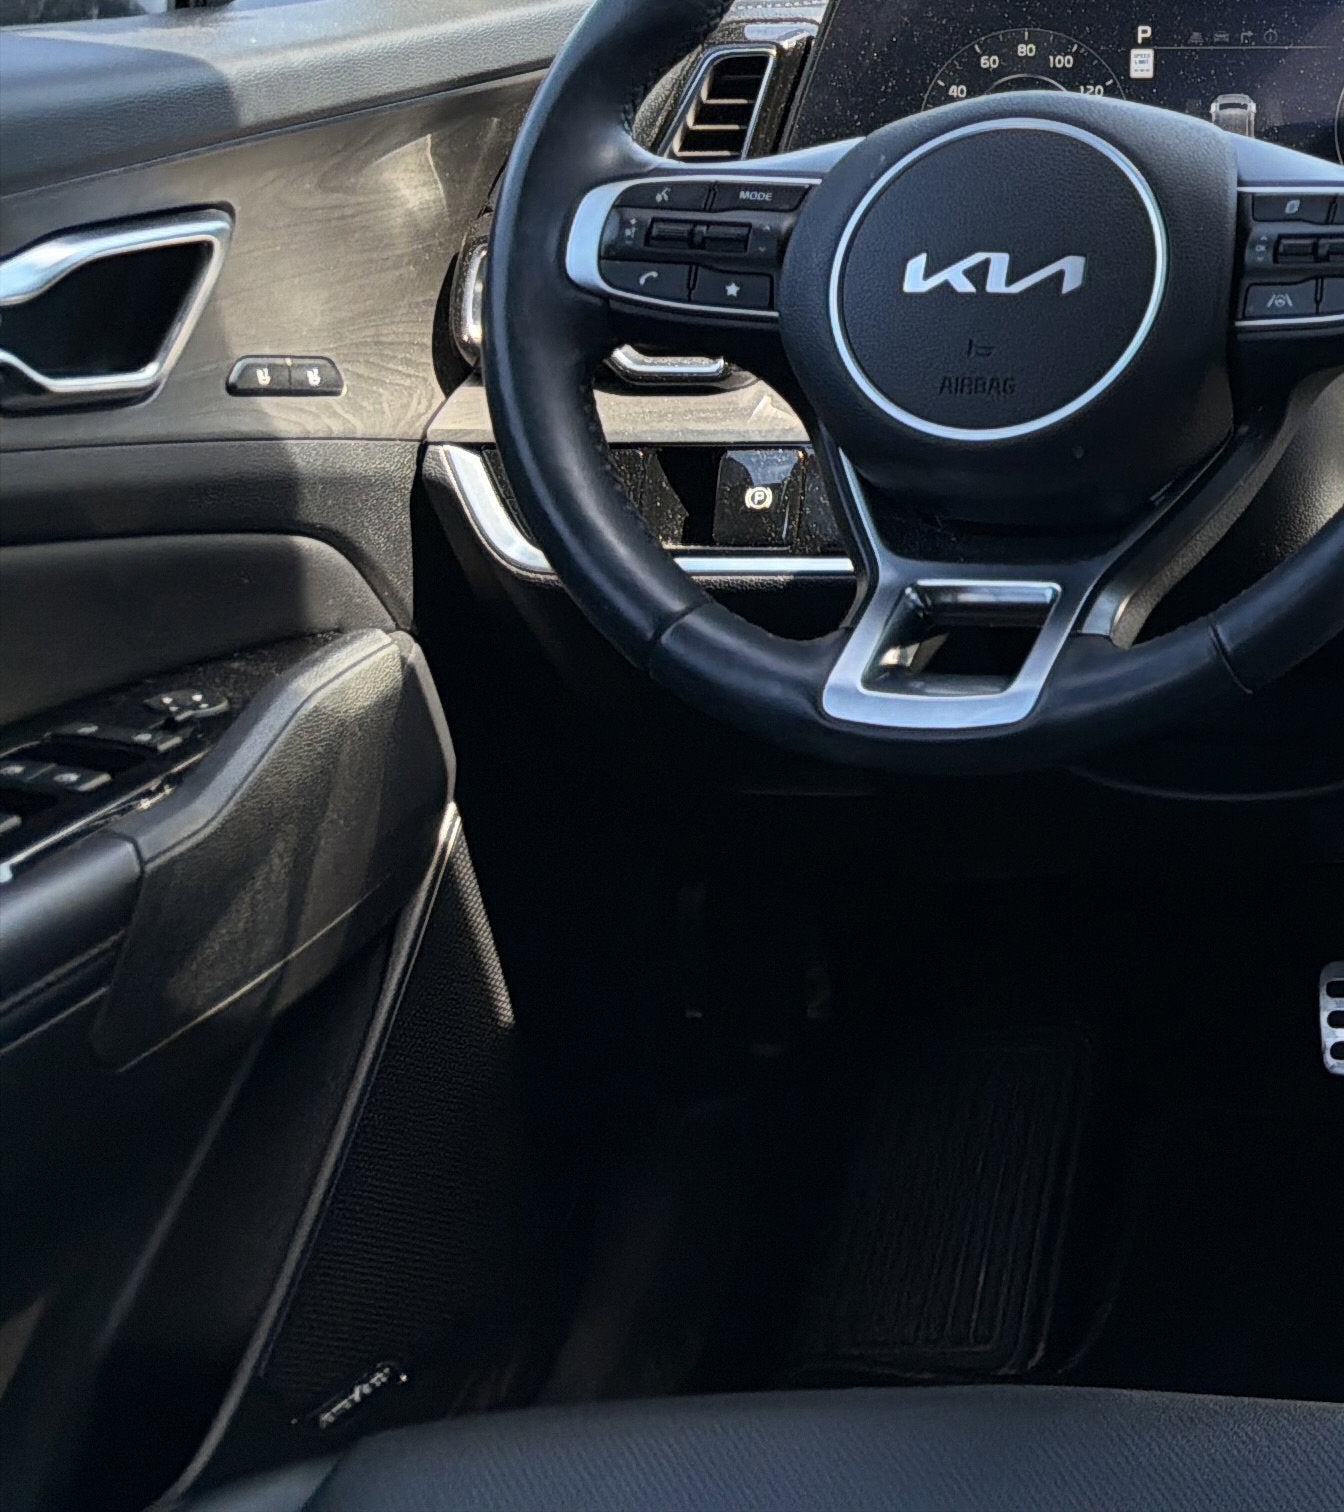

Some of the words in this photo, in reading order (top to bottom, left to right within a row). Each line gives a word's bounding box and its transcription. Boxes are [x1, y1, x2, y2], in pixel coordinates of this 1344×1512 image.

[1137, 25, 1152, 44] P
[1017, 43, 1036, 57] 80
[980, 54, 999, 68] 60
[1048, 55, 1074, 69] 100
[948, 84, 967, 99] 40
[1079, 84, 1104, 97] 120
[739, 190, 773, 201] MODE
[903, 252, 1086, 294] KIA
[939, 376, 1016, 396] AIRBAG
